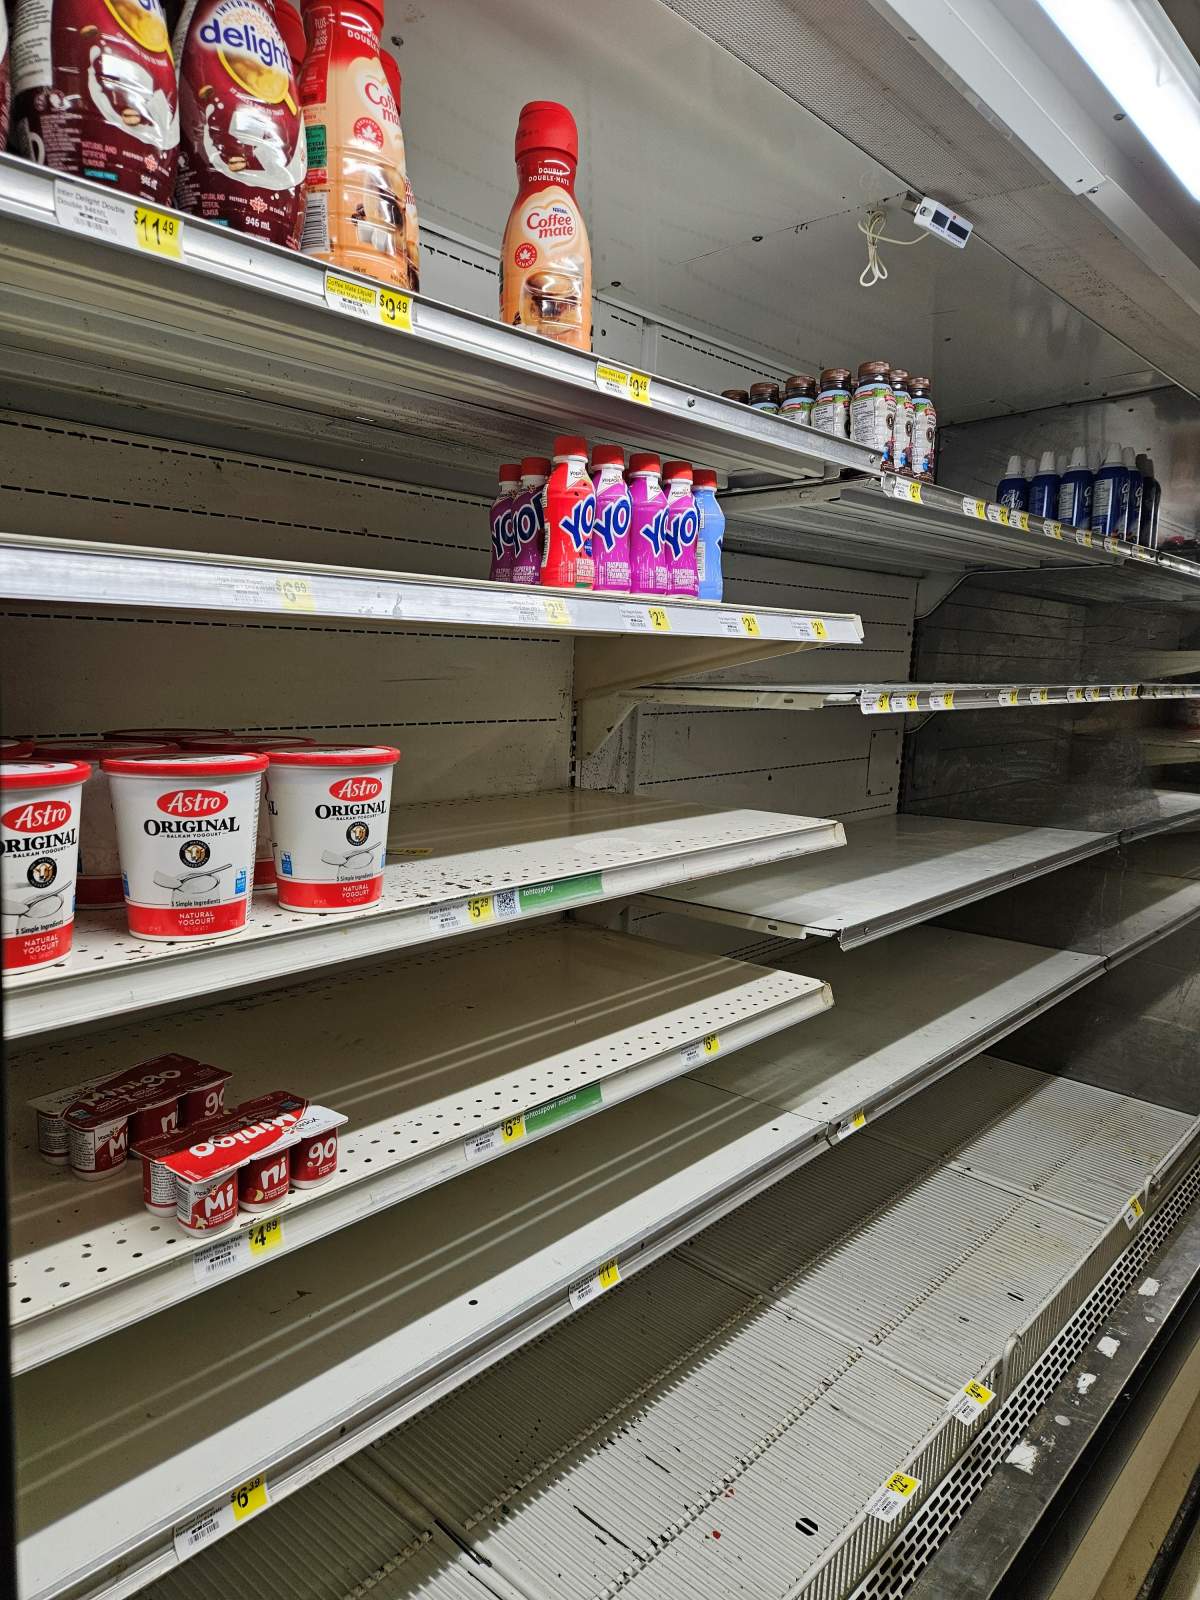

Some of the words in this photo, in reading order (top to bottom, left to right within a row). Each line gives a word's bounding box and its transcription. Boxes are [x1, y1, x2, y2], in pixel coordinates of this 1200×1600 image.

[200, 19, 291, 74] delight
[364, 82, 399, 113] Coff
[538, 167, 564, 176] DOUBLE
[245, 216, 260, 228] 946
[527, 212, 572, 230] Coffee
[539, 224, 574, 239] mate
[338, 779, 378, 798] Astro
[167, 792, 220, 813] Astro
[314, 800, 387, 820] ORIGINAL
[14, 804, 67, 830] Astro
[143, 816, 240, 836] ORIGINAL
[12, 851, 40, 859] BALKAN
[341, 890, 369, 898] YOGOURT
[342, 883, 369, 892] NATURAL
[175, 900, 193, 908] Simple
[193, 898, 221, 907] Ingredients
[178, 917, 215, 926] YOGOURT
[179, 911, 214, 919] NATURAL
[20, 924, 40, 935] Simple
[40, 919, 64, 932] Ingredients
[23, 940, 59, 955] YOGOURT
[24, 934, 59, 948] NATURAL
[260, 1156, 287, 1190] ni
[204, 1183, 234, 1218] Mi
